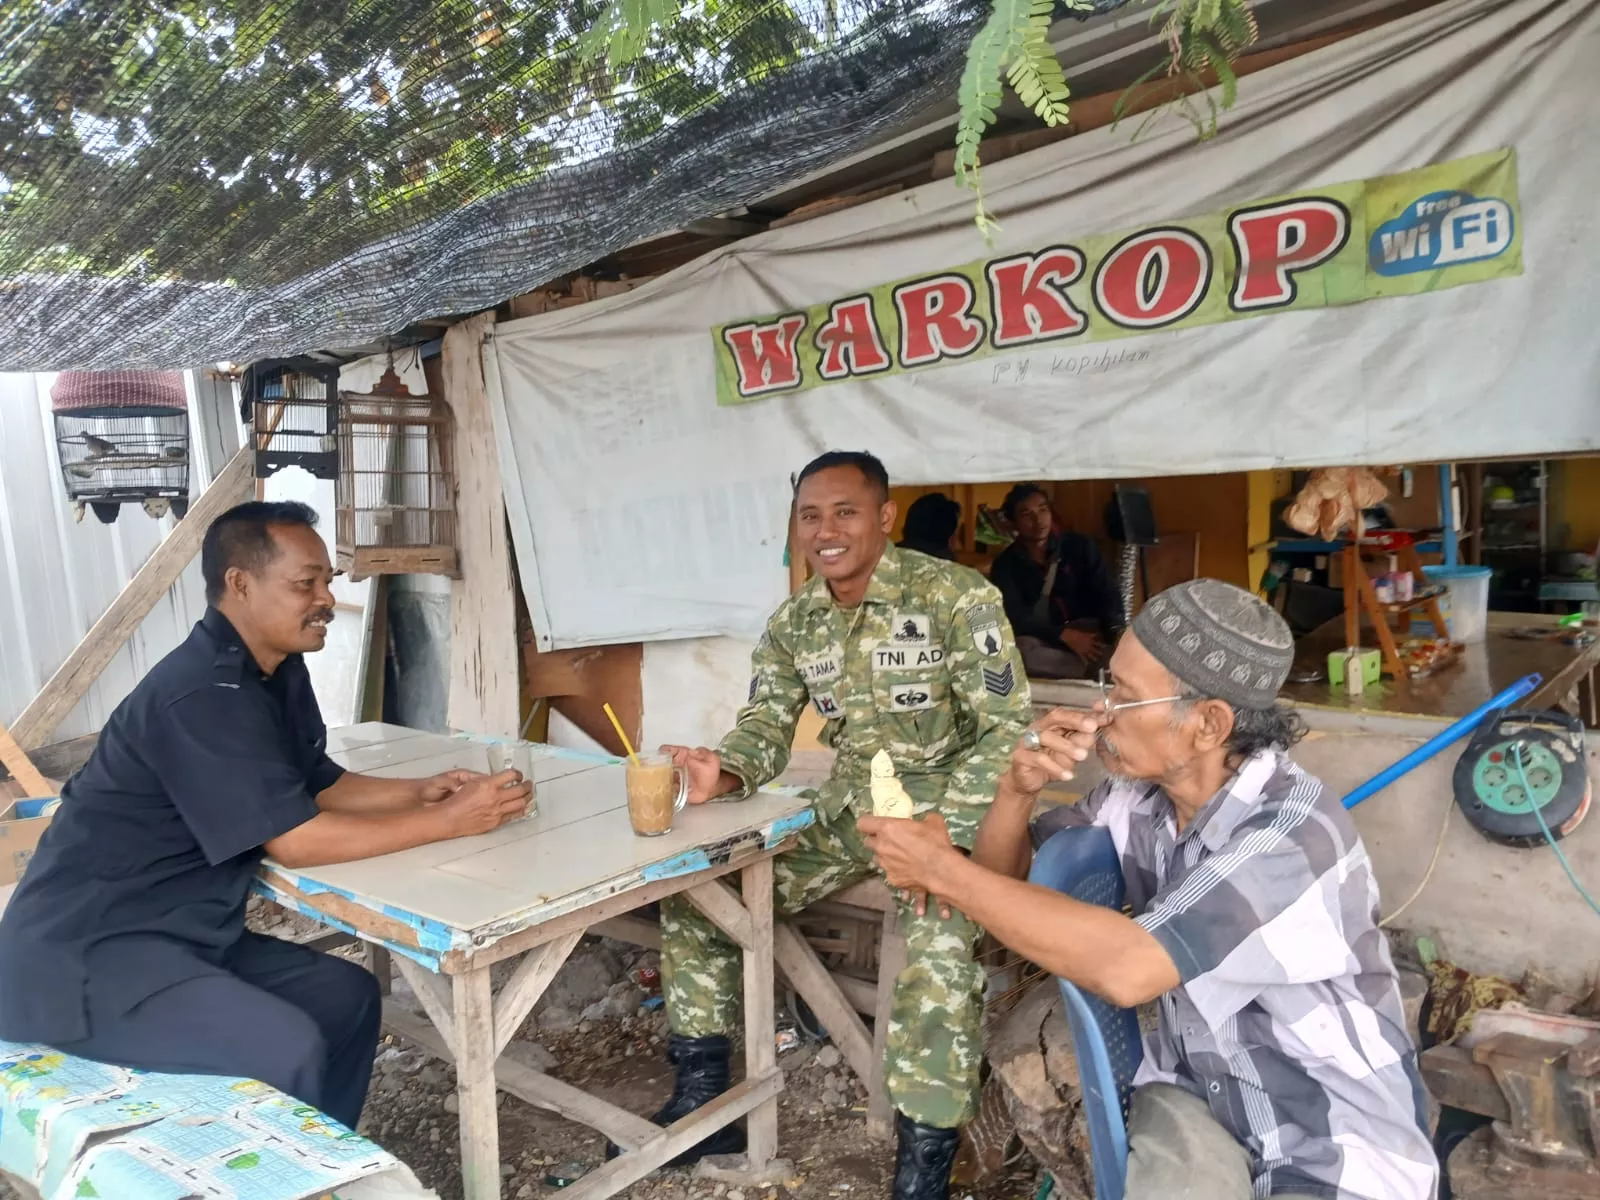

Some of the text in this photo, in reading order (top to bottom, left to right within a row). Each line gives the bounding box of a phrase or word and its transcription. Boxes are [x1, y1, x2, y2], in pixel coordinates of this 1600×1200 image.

[1416, 196, 1461, 217] Free
[1381, 208, 1498, 263] Wi Fi
[722, 196, 1352, 397] WARKOP
[877, 649, 943, 666] TNI AD
